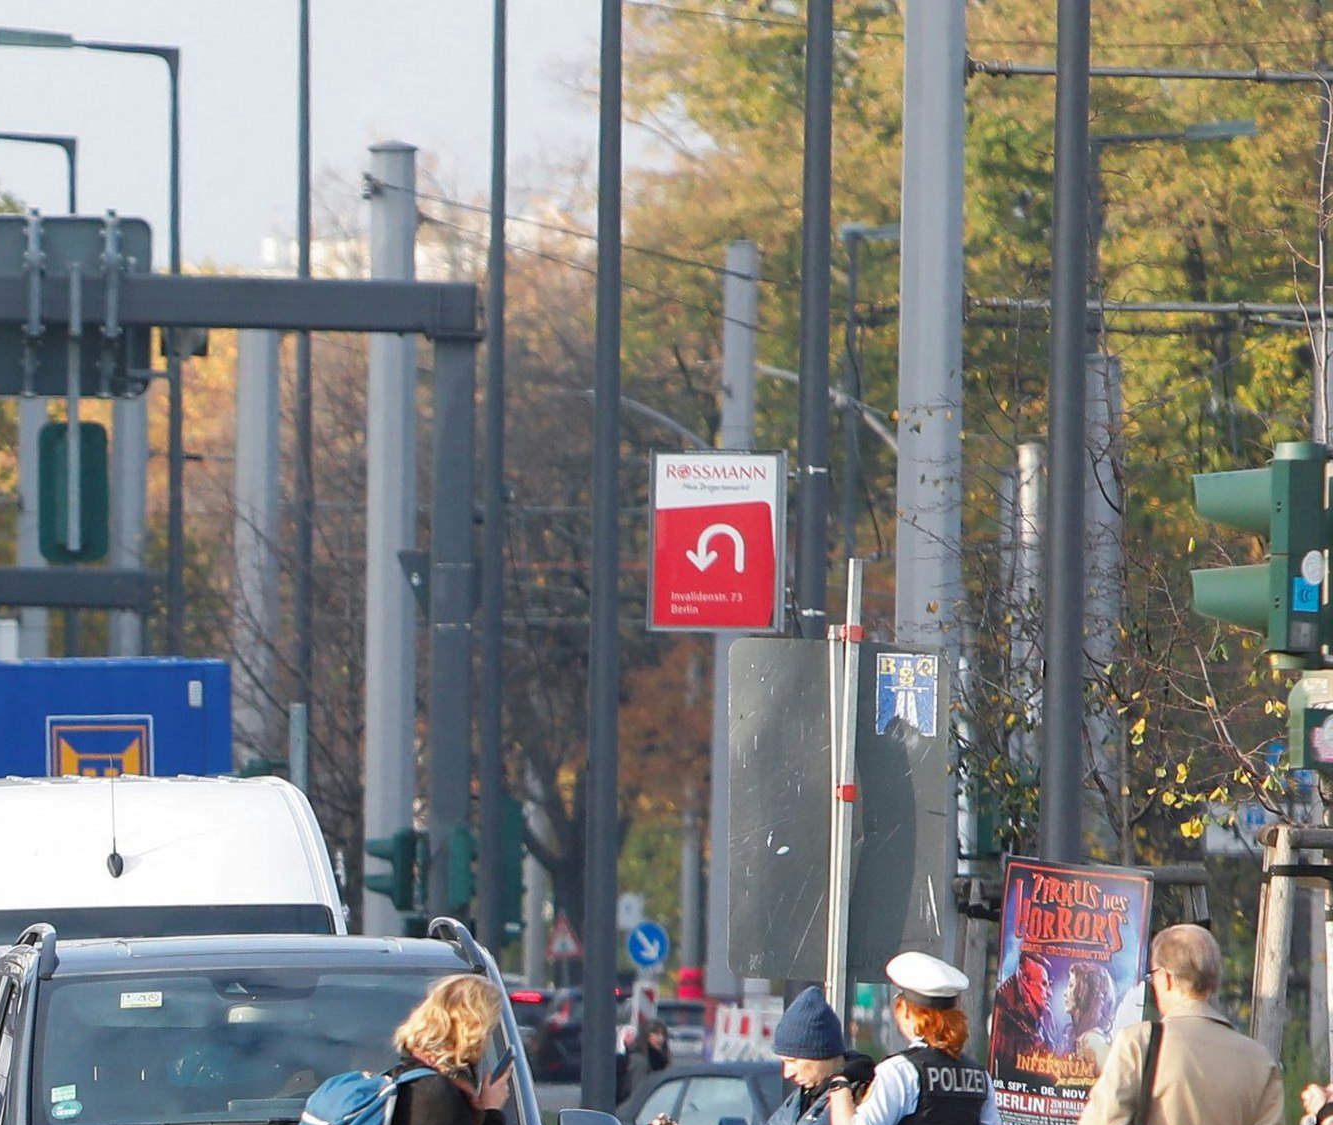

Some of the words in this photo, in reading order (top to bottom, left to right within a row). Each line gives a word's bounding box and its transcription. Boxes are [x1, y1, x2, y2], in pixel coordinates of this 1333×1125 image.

[666, 464, 767, 480] ROSSMANN
[671, 604, 699, 615] Berlin
[1015, 878, 1129, 952] HORRORS
[1062, 1088, 1089, 1100] NOV.
[994, 1092, 1046, 1114] BERLIN
